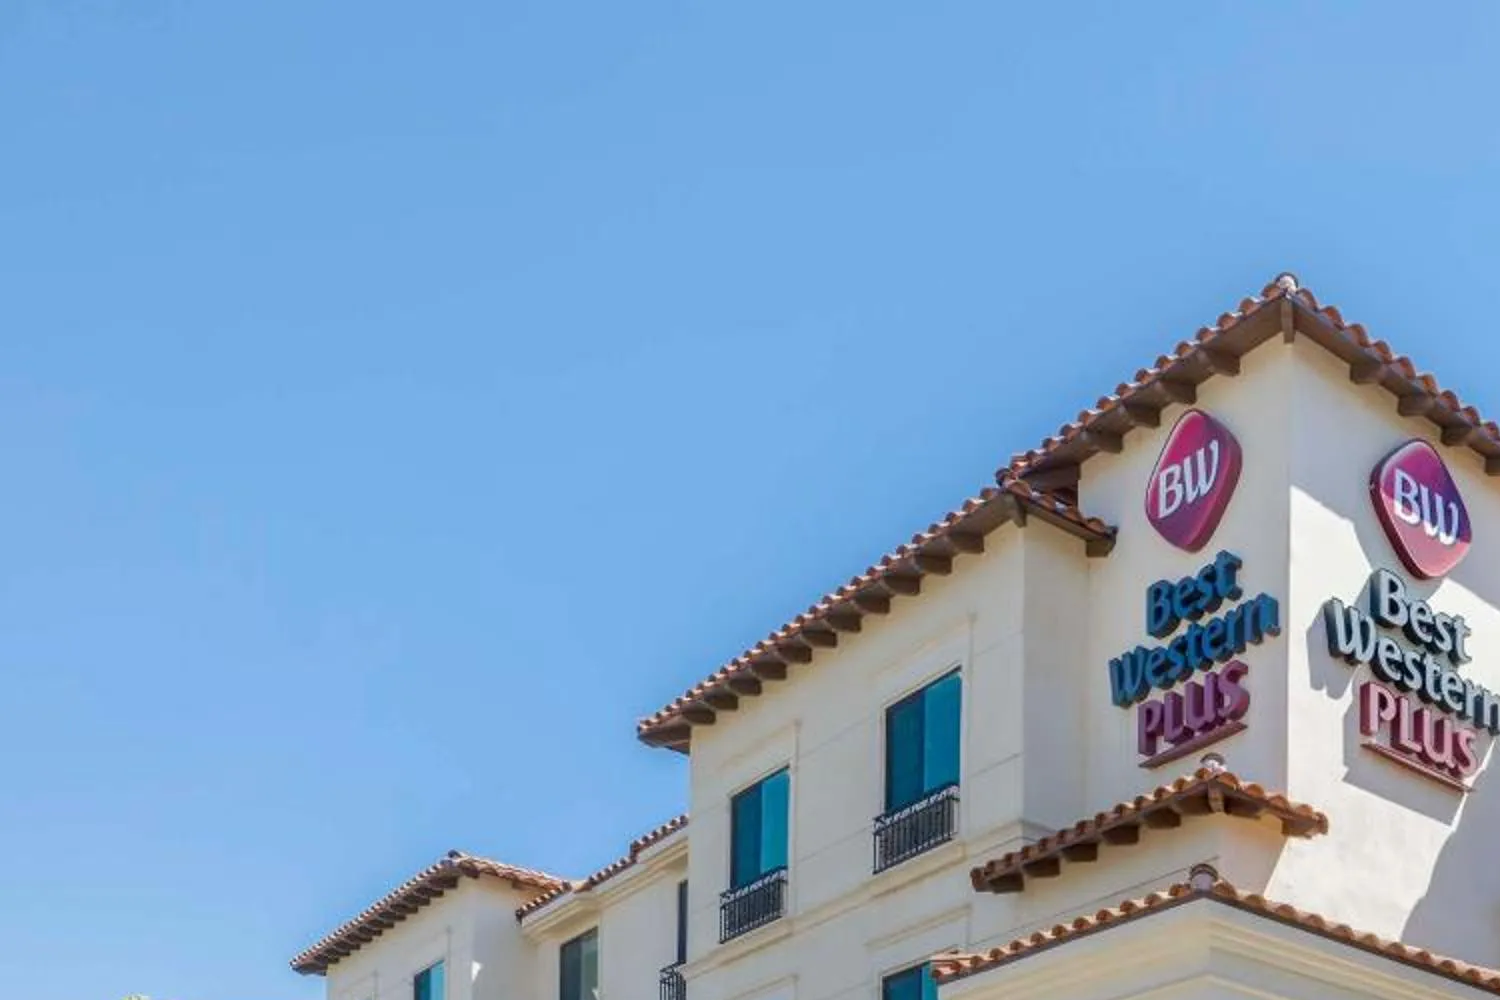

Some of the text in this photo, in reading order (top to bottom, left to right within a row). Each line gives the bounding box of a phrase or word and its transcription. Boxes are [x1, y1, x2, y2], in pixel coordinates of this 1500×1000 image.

[1156, 438, 1220, 519] BW
[1392, 468, 1460, 546] BW
[1145, 549, 1244, 640] Best
[1370, 567, 1473, 664] Best
[1107, 591, 1281, 710] Western
[1137, 659, 1250, 758] PLUS
[1359, 681, 1480, 781] PLUS
